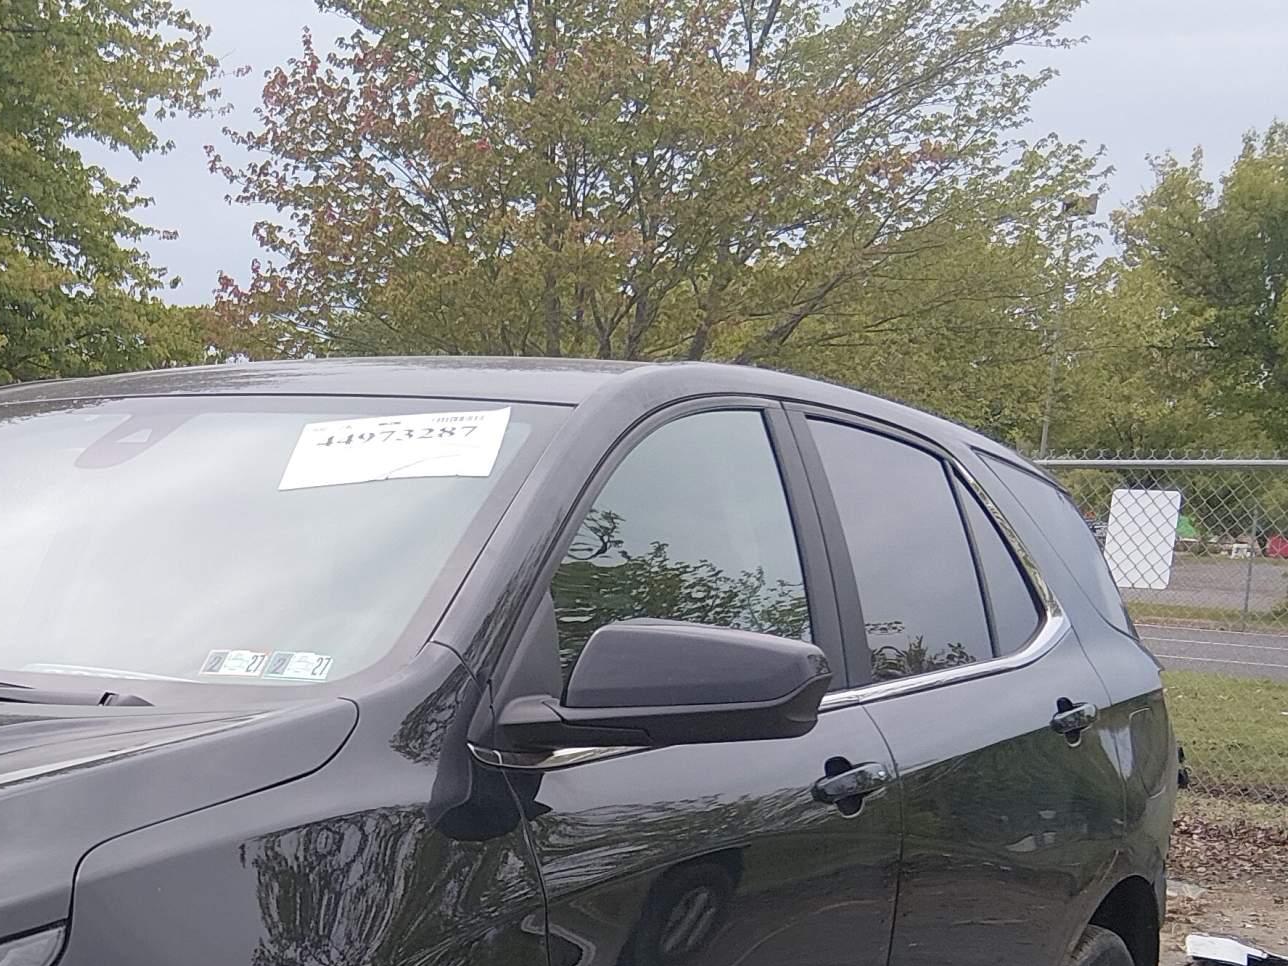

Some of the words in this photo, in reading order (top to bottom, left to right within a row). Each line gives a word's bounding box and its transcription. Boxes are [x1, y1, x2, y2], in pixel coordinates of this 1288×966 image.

[316, 425, 478, 447] 44973287
[245, 654, 266, 673] 27
[312, 656, 331, 676] 27
